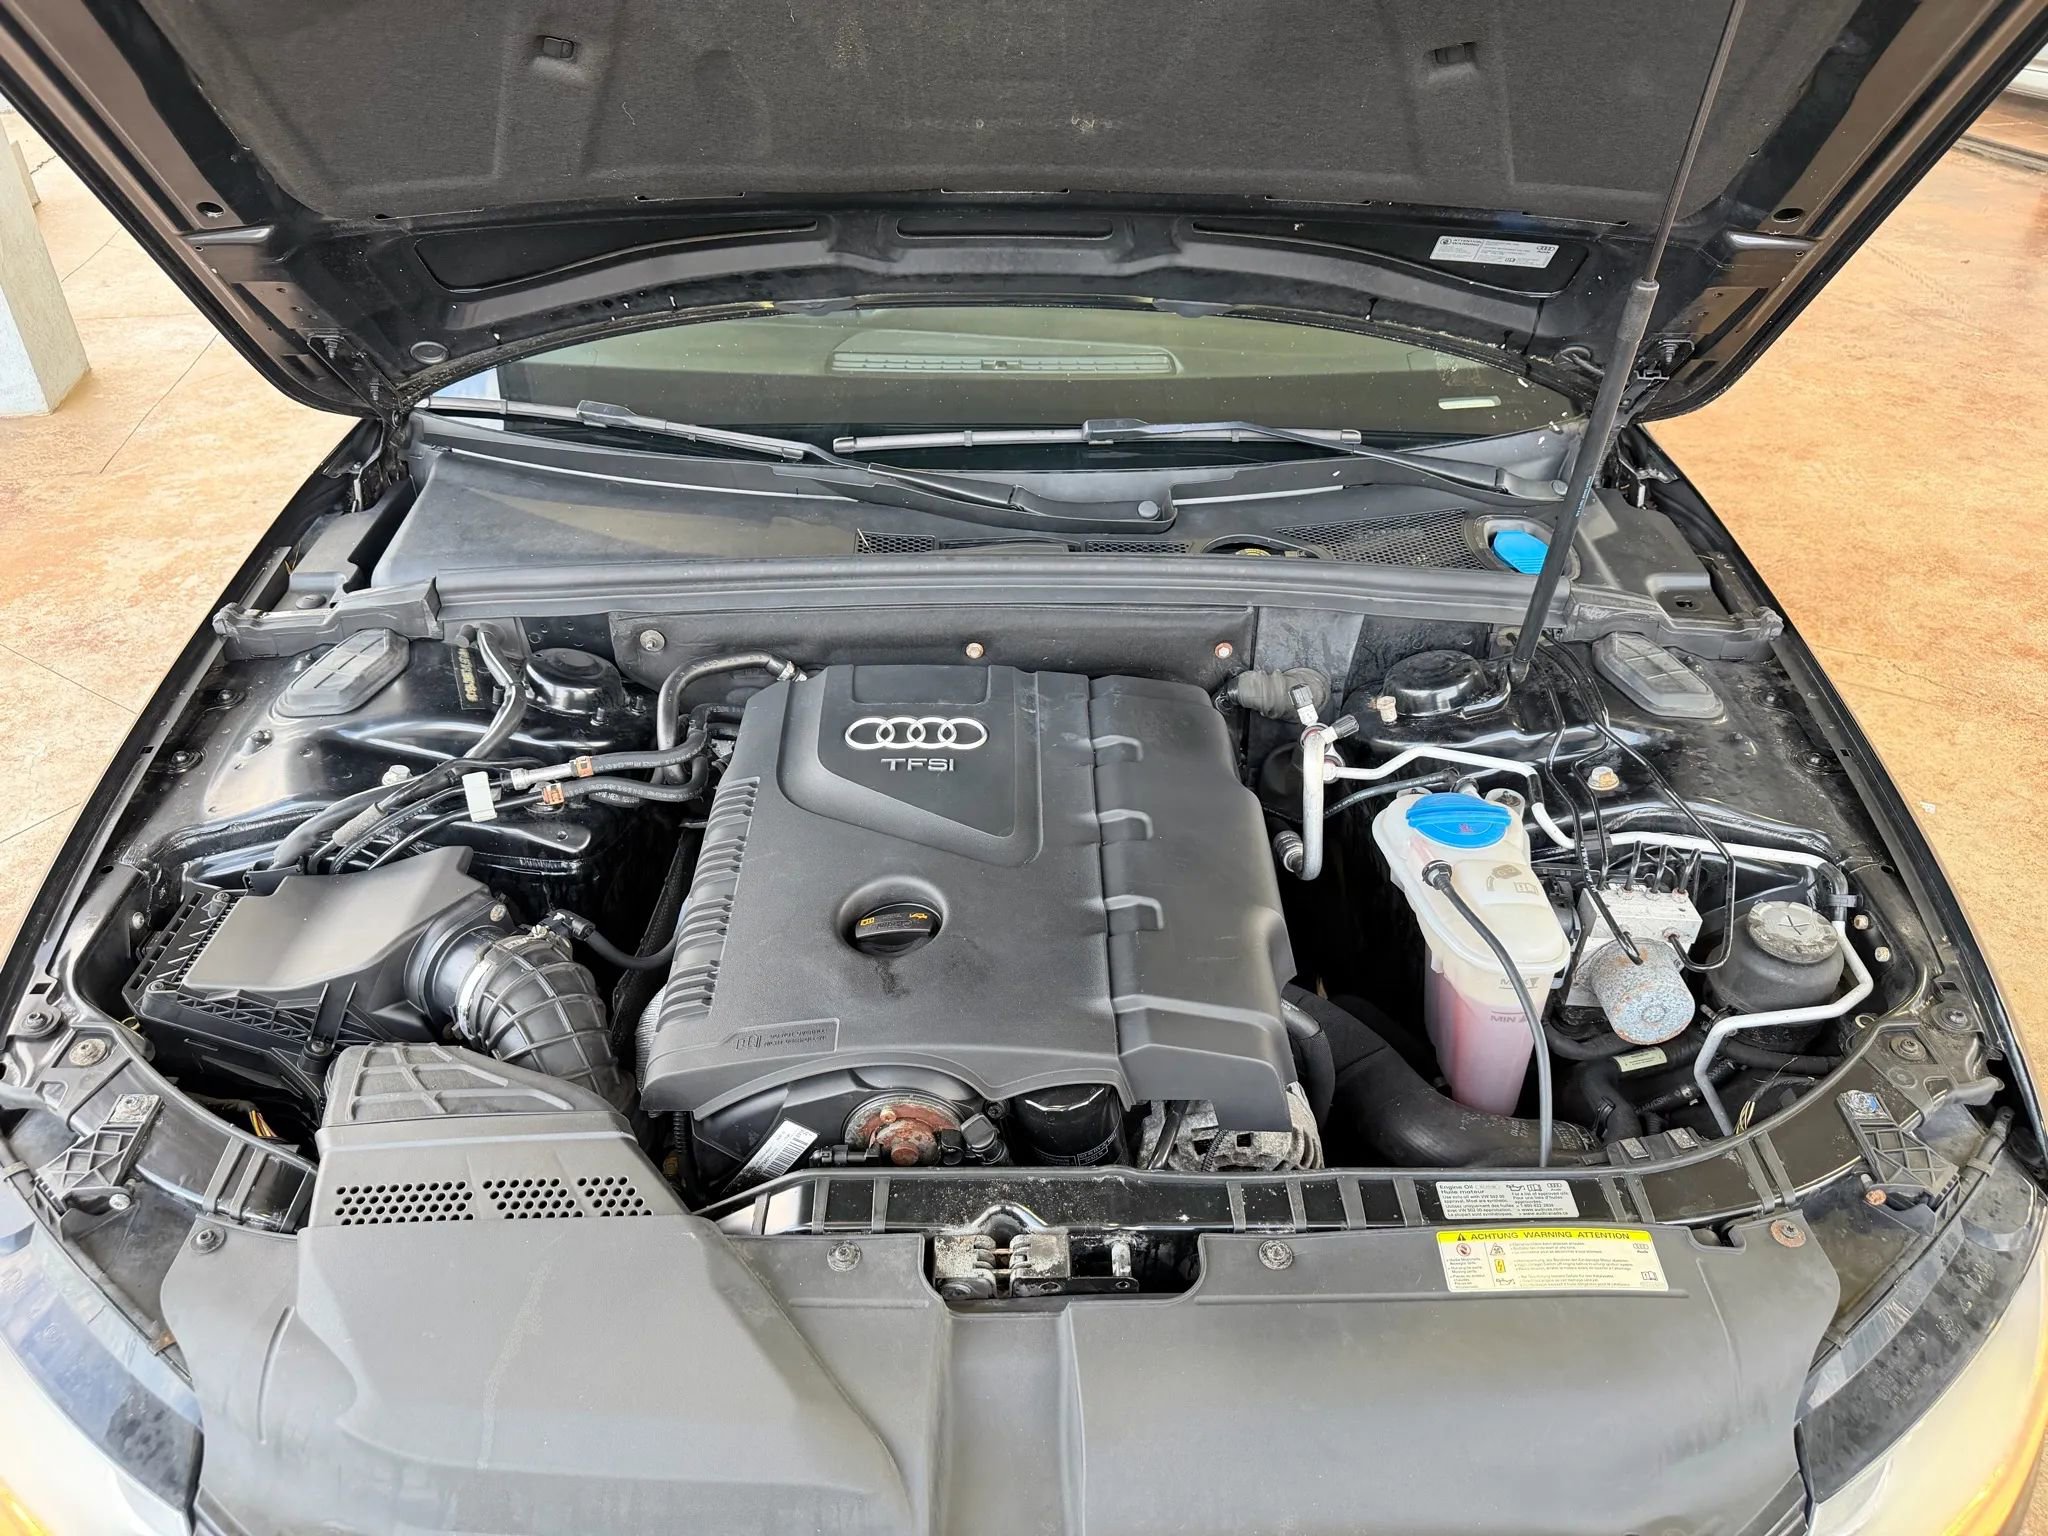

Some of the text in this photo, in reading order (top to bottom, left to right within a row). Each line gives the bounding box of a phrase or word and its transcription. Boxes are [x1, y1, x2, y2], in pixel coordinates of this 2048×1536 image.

[880, 758, 954, 771] TFSI
[1490, 1015, 1517, 1023] MIN
[1471, 1232, 1518, 1240] ACHTUNG
[1577, 1231, 1630, 1239] ATTENTION
